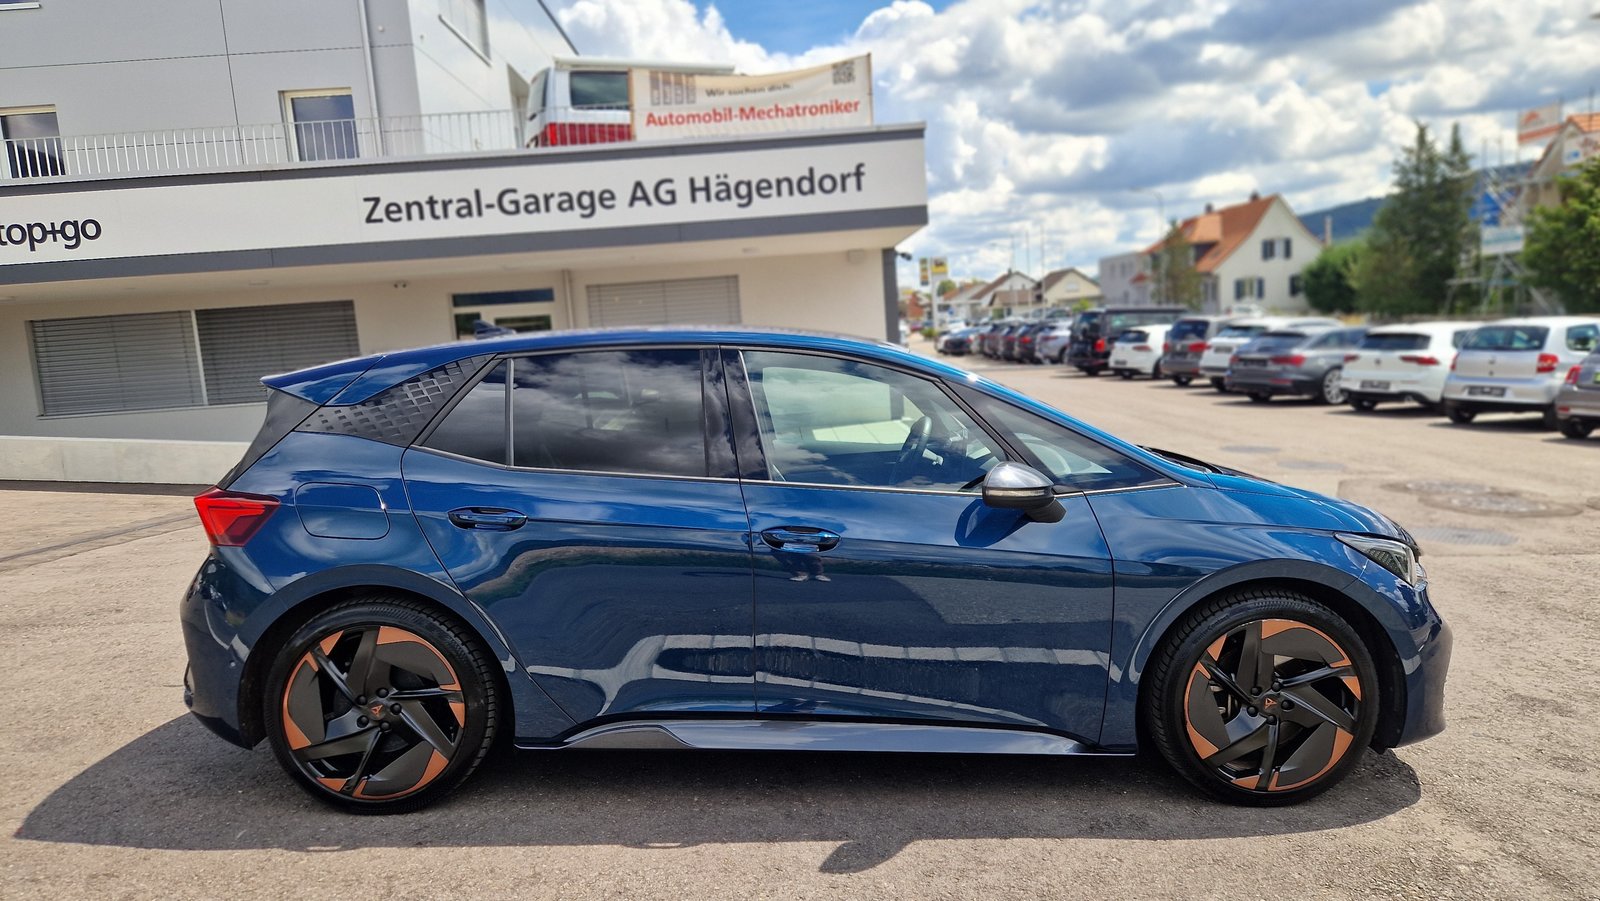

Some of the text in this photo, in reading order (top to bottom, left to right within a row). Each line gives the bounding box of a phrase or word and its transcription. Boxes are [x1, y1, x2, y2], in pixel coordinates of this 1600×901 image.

[645, 98, 860, 127] Automobil-Mechatroniker
[363, 162, 866, 219] Zentral-Garage AG Hägendorf
